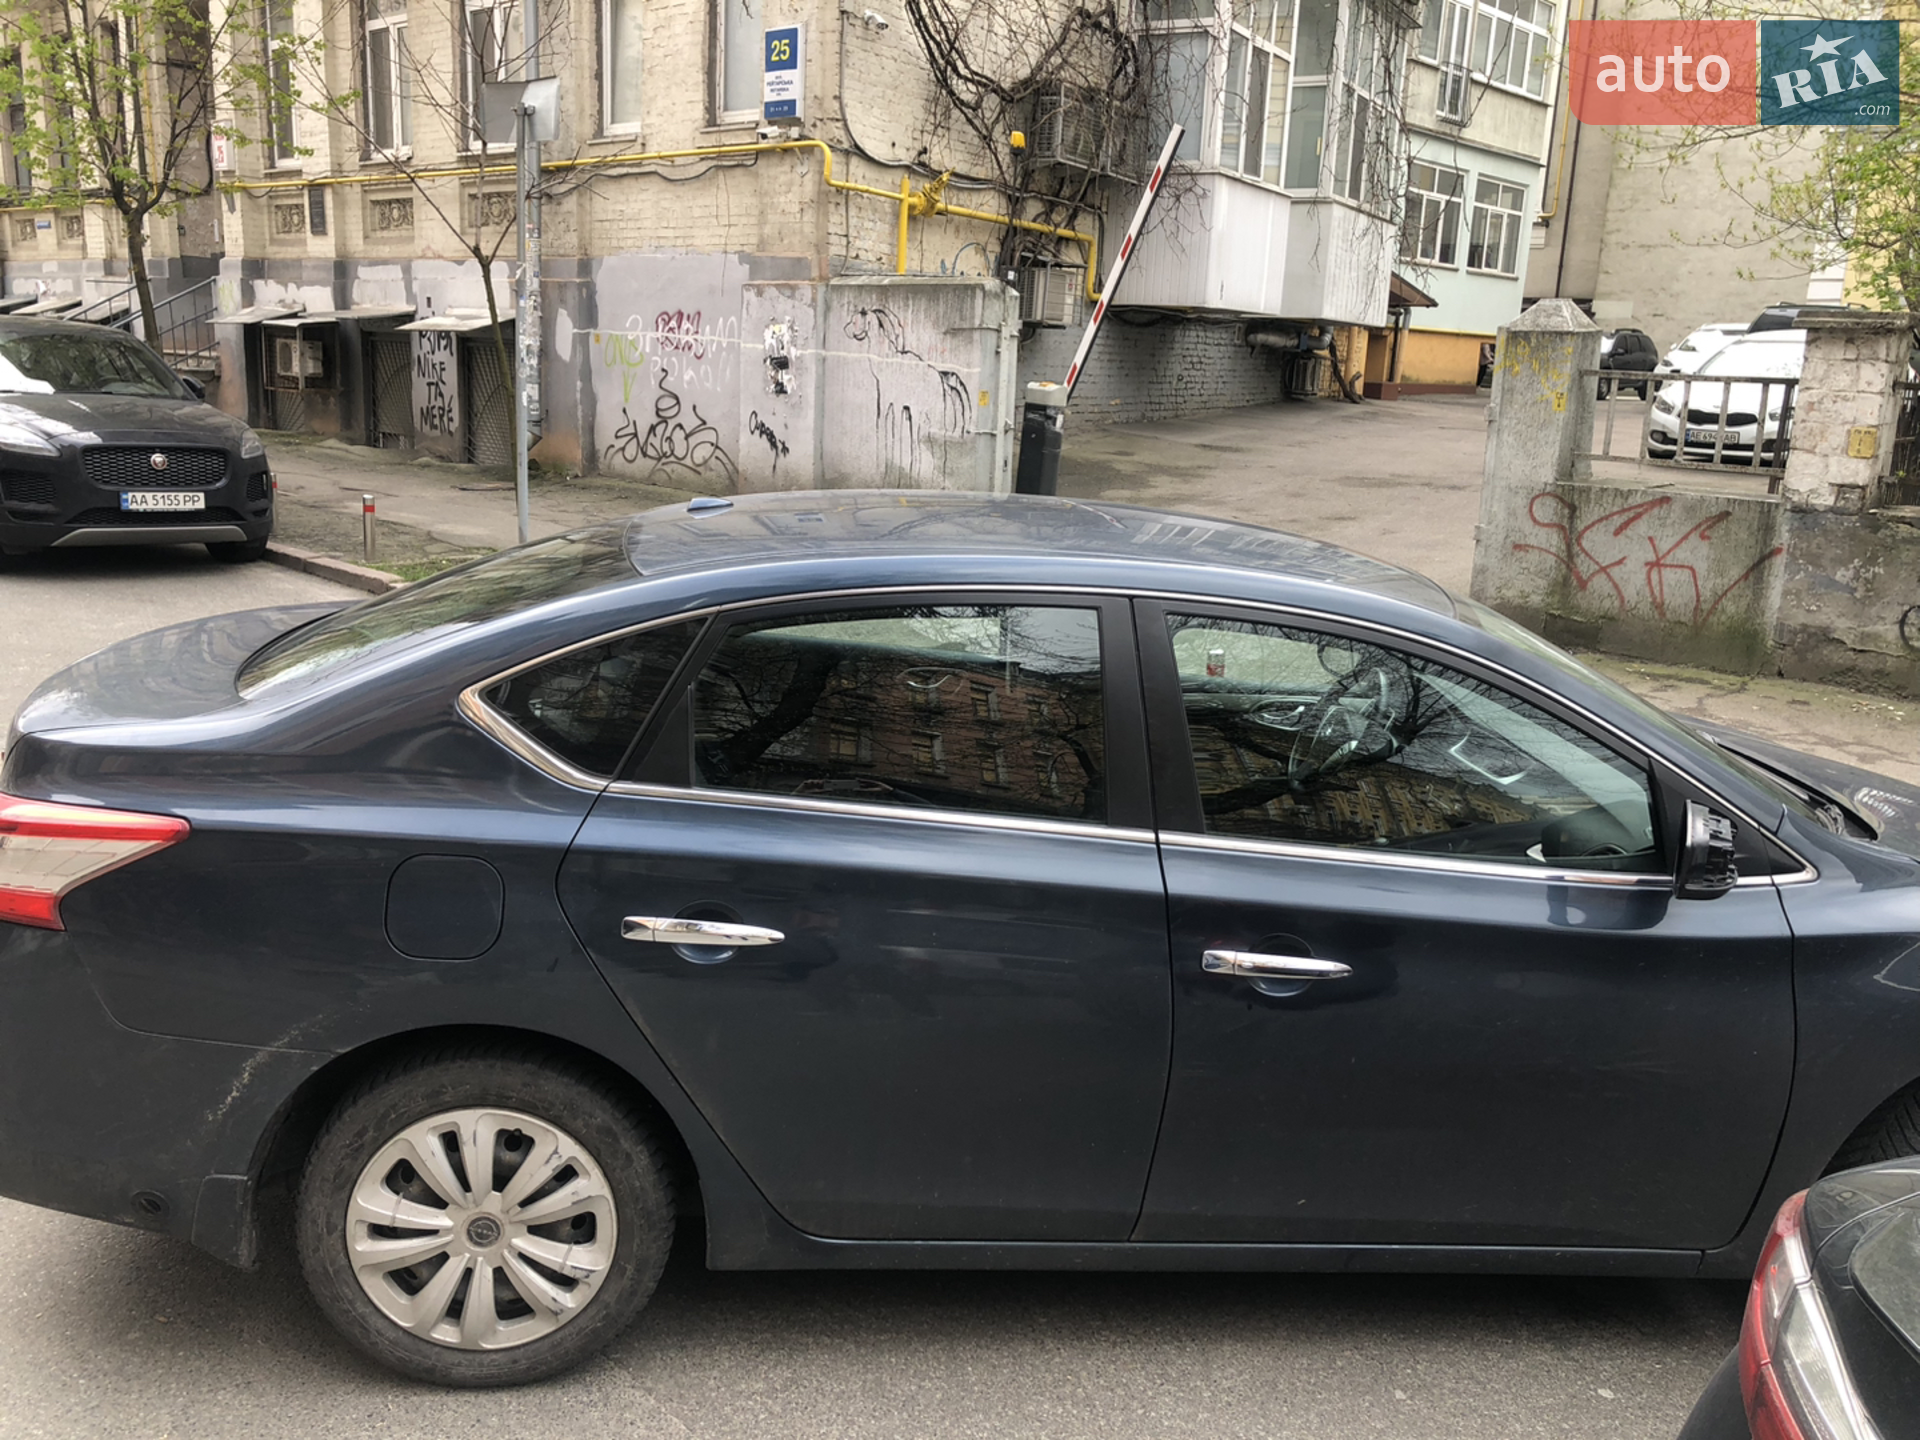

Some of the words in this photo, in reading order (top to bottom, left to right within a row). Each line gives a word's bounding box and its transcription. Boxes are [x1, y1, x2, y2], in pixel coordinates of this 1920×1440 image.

[771, 40, 790, 61] 25
[426, 381, 446, 411] TA
[130, 494, 148, 506] AA
[151, 494, 181, 506] 5155
[183, 494, 201, 506] PP
